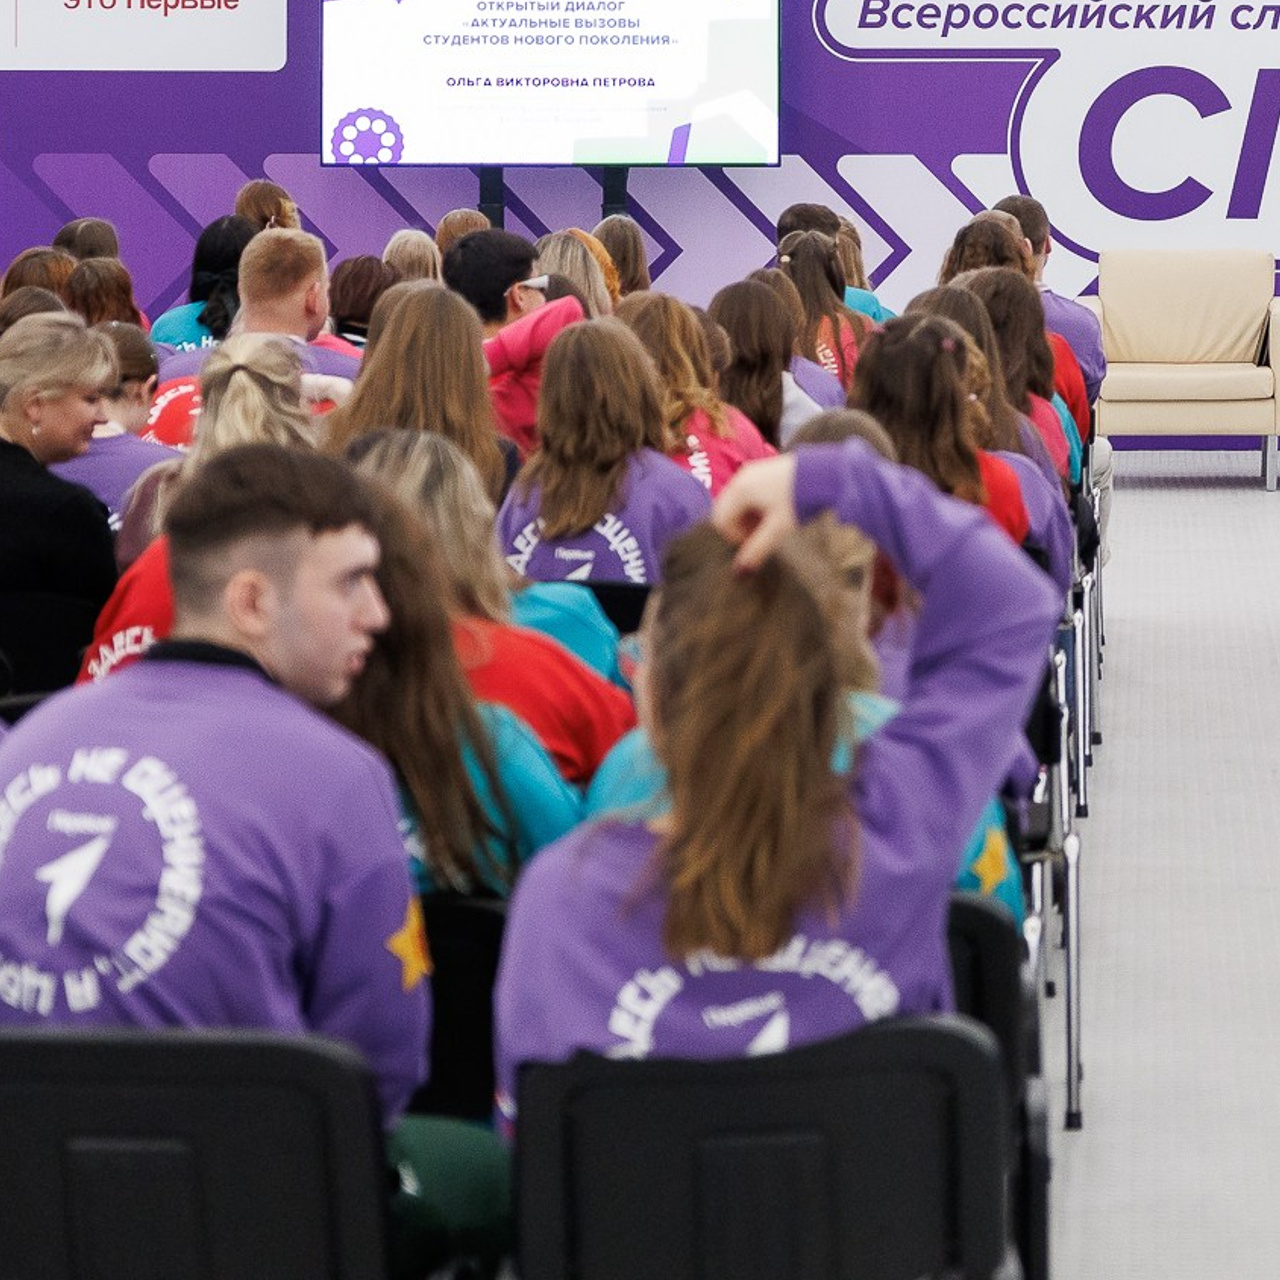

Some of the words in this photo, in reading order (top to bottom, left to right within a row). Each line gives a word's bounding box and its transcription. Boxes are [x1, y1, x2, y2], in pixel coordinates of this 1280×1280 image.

[564, 0, 626, 13] ДИАЛОГ
[574, 18, 641, 28] ВЫЗОВЫ
[423, 34, 510, 46] СТУДЕНТОВ
[513, 34, 575, 45] НОВОГО
[446, 77, 492, 87] ОЛЬГА
[495, 77, 589, 87] ВИКТОРОВНА
[592, 77, 656, 87] ПЕТРОВА
